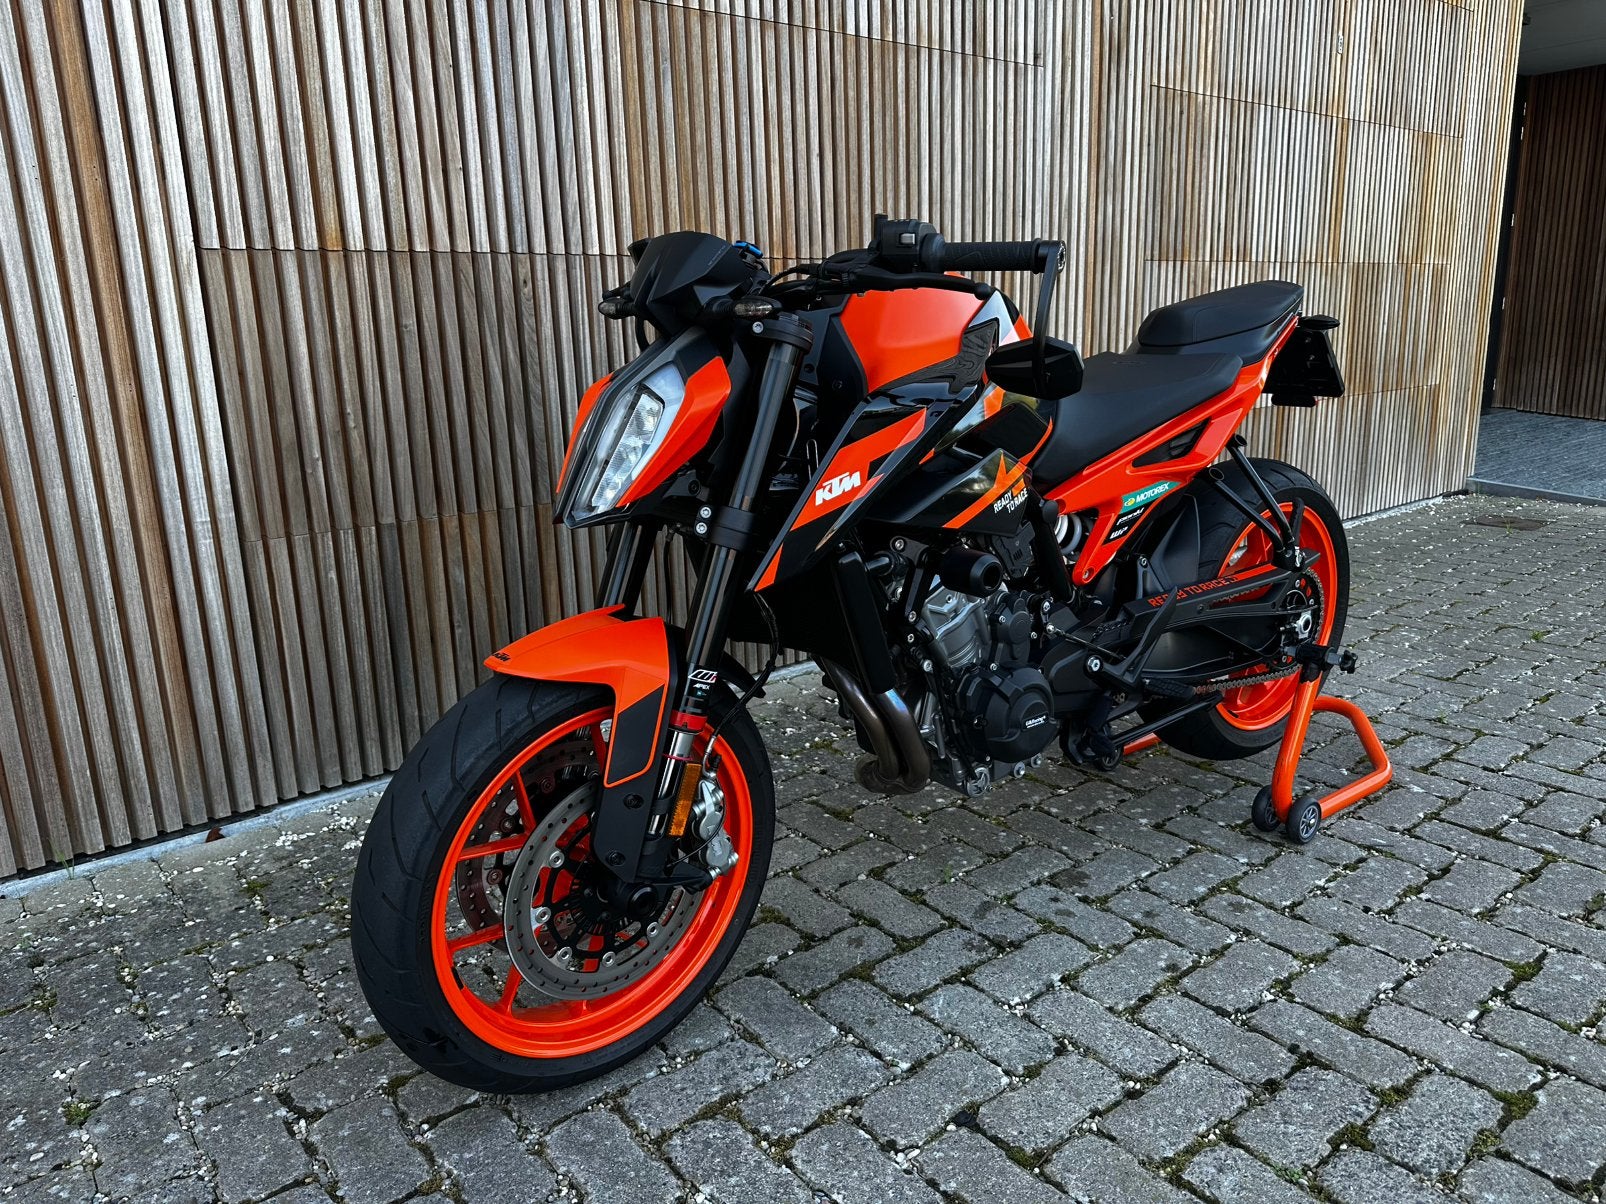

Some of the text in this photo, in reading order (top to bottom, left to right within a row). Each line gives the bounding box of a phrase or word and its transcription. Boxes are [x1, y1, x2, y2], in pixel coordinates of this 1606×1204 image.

[815, 471, 861, 506] KTM
[1006, 487, 1029, 514] TO RACE
[1135, 481, 1170, 503] MOTOREX
[993, 489, 1012, 514] READY
[1184, 584, 1203, 595] TO
[1199, 577, 1229, 591] RACE
